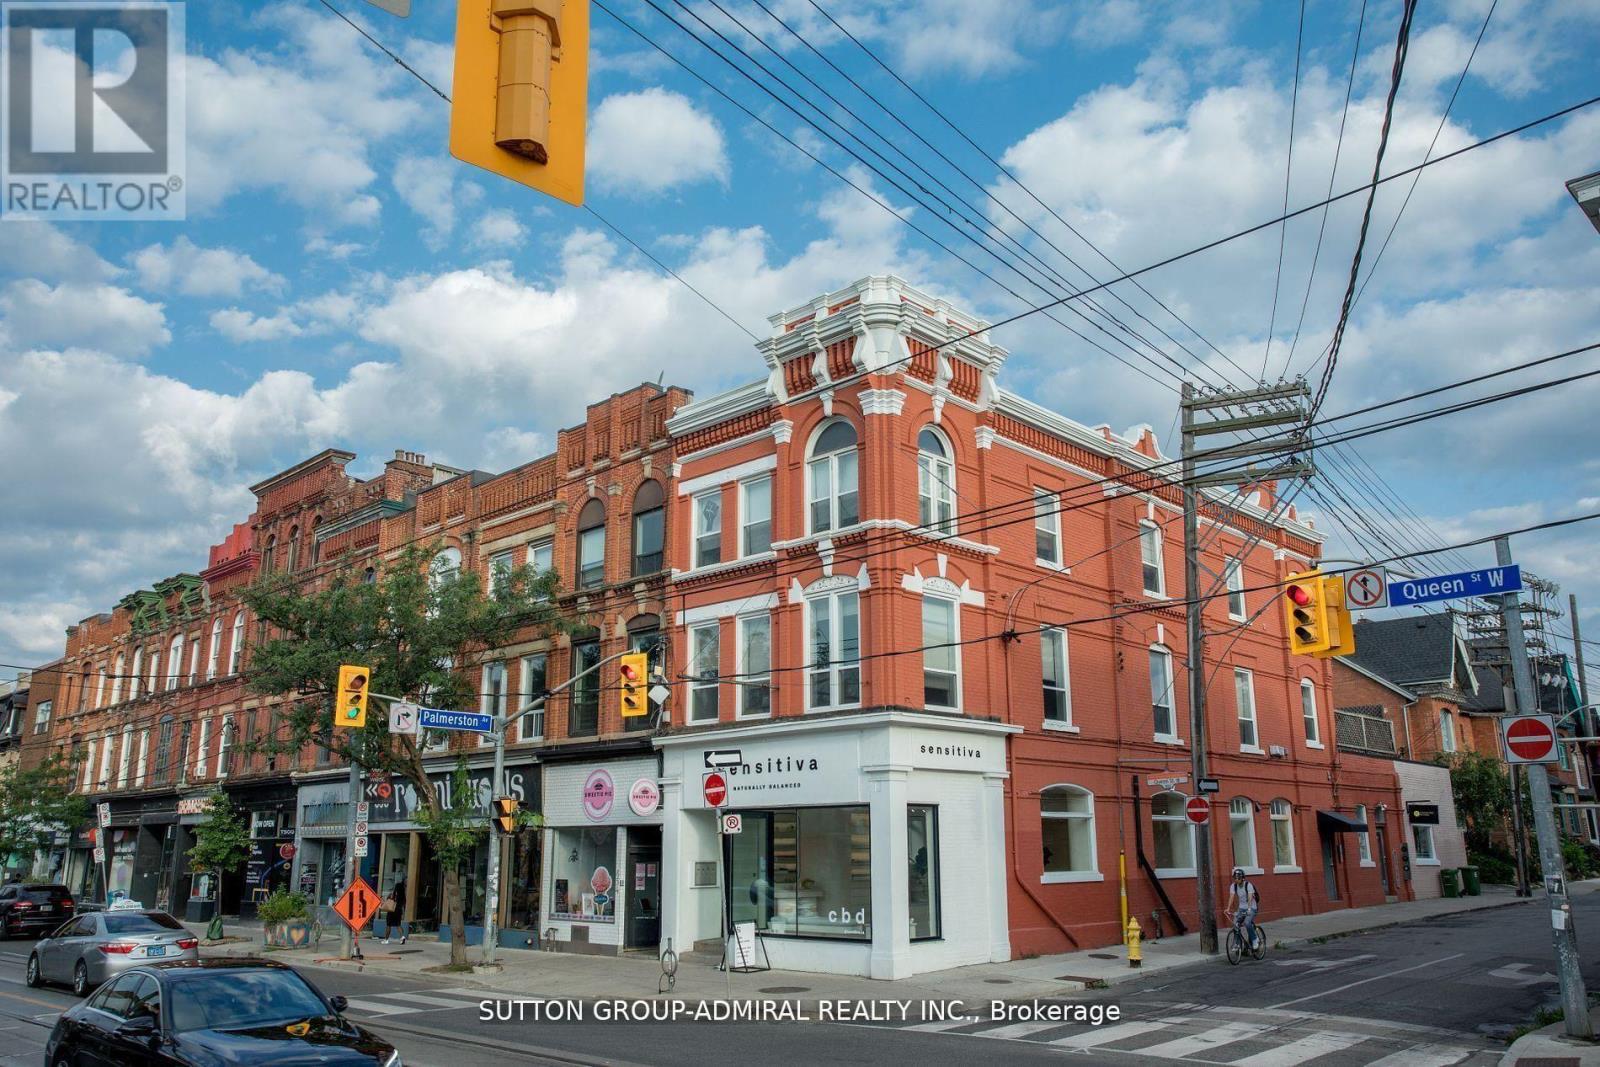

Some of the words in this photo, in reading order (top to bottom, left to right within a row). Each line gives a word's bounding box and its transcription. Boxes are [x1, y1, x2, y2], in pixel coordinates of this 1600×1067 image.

[1402, 577, 1464, 599] Queen
[1471, 573, 1481, 582] St
[1487, 569, 1503, 587] W
[423, 711, 478, 727] Palmerston
[920, 744, 981, 758] sensitiva
[718, 756, 818, 775] ensitiva
[828, 907, 865, 924] cbd
